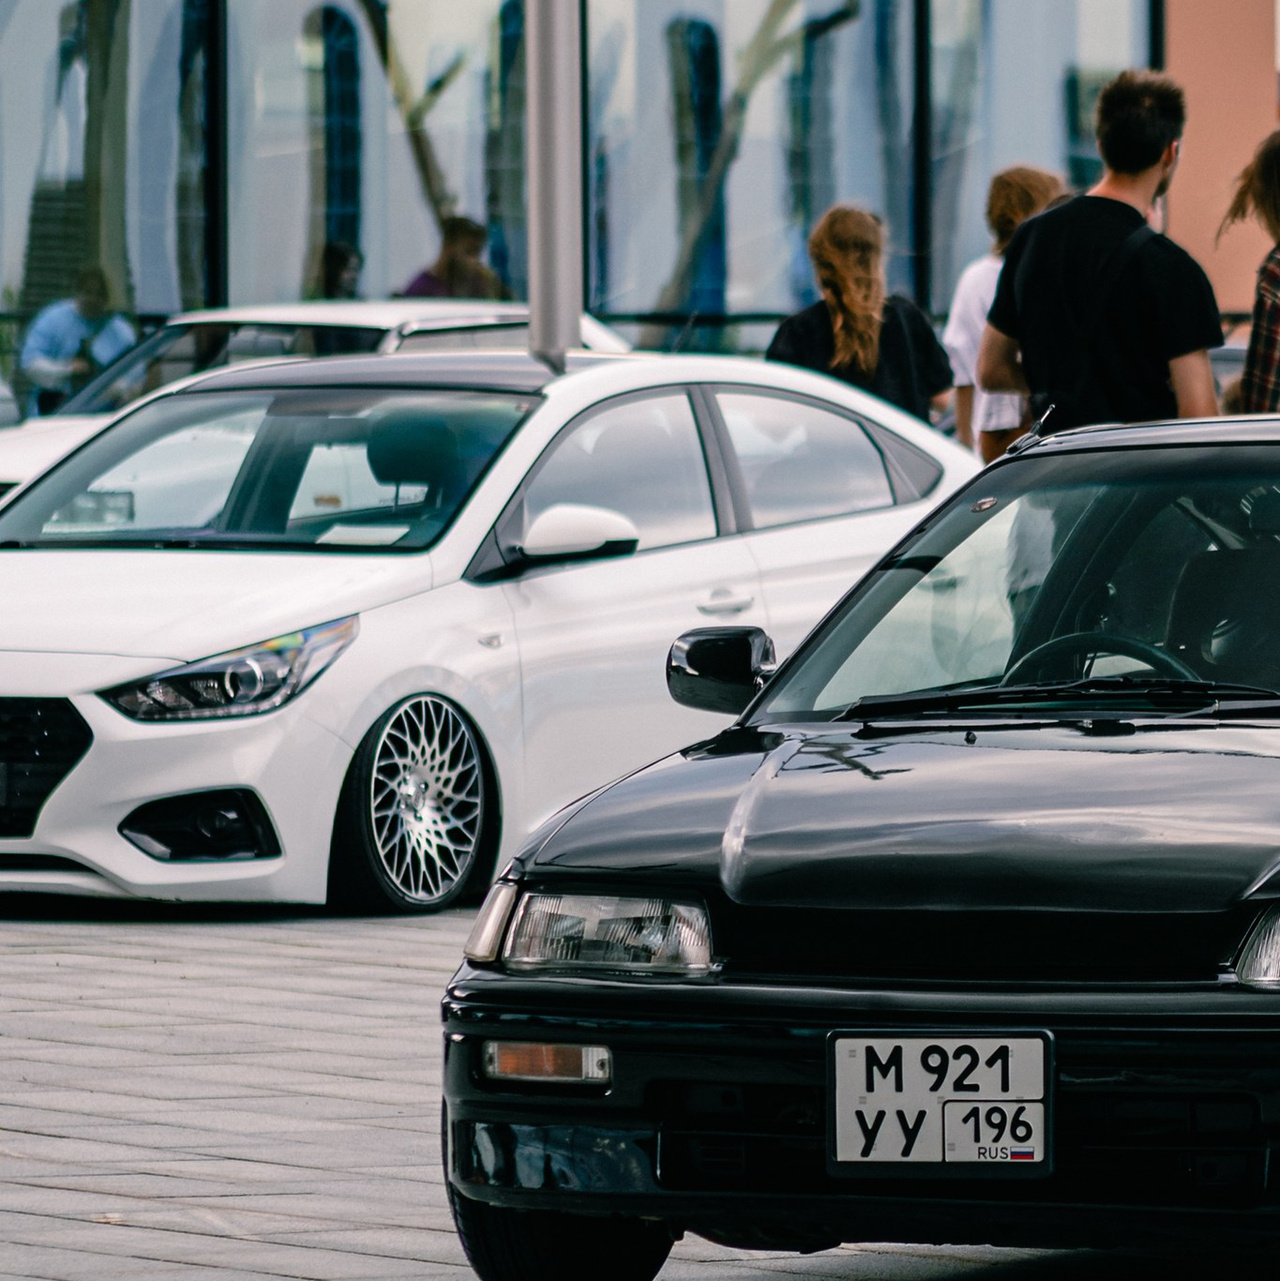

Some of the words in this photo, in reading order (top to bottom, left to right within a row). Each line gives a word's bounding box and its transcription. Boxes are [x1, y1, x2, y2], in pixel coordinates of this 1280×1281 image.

[920, 1044, 1010, 1093] 921
[961, 1106, 1034, 1143] 196
[977, 1147, 1009, 1160] RUS
